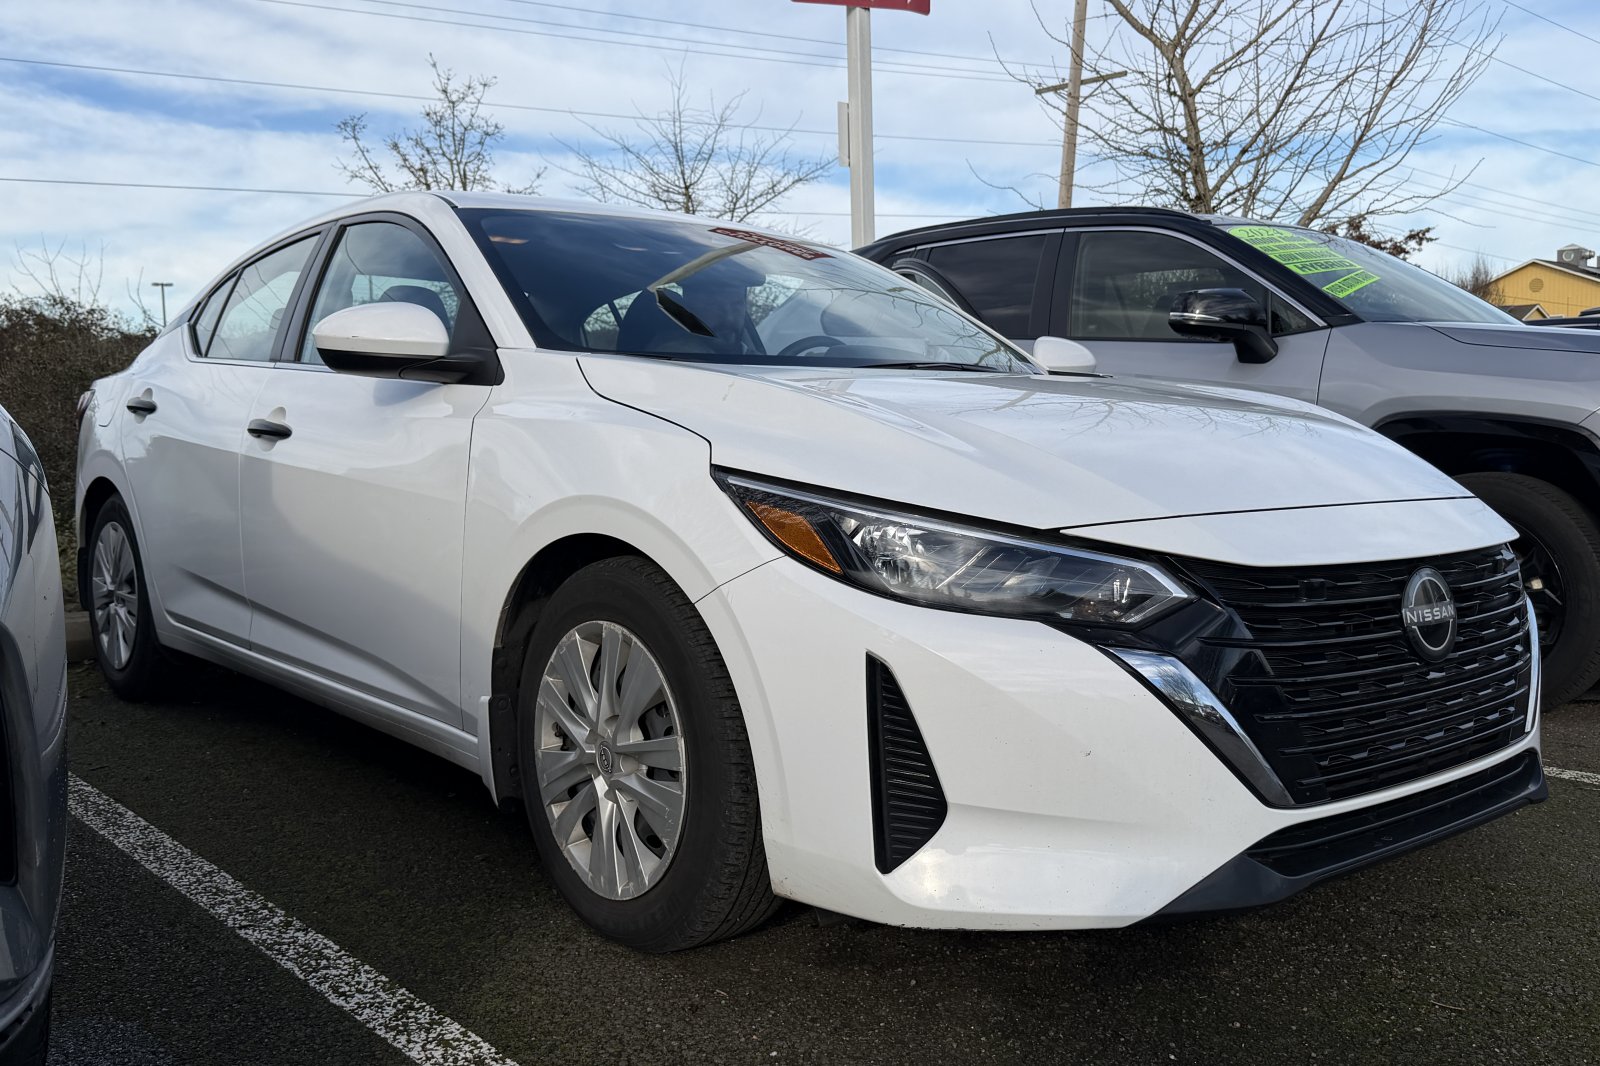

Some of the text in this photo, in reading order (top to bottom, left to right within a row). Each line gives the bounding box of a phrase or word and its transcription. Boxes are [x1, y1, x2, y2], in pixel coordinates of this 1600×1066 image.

[1238, 228, 1285, 238] 2024
[1295, 260, 1356, 272] HYBRID
[1406, 604, 1455, 624] NISSAN
